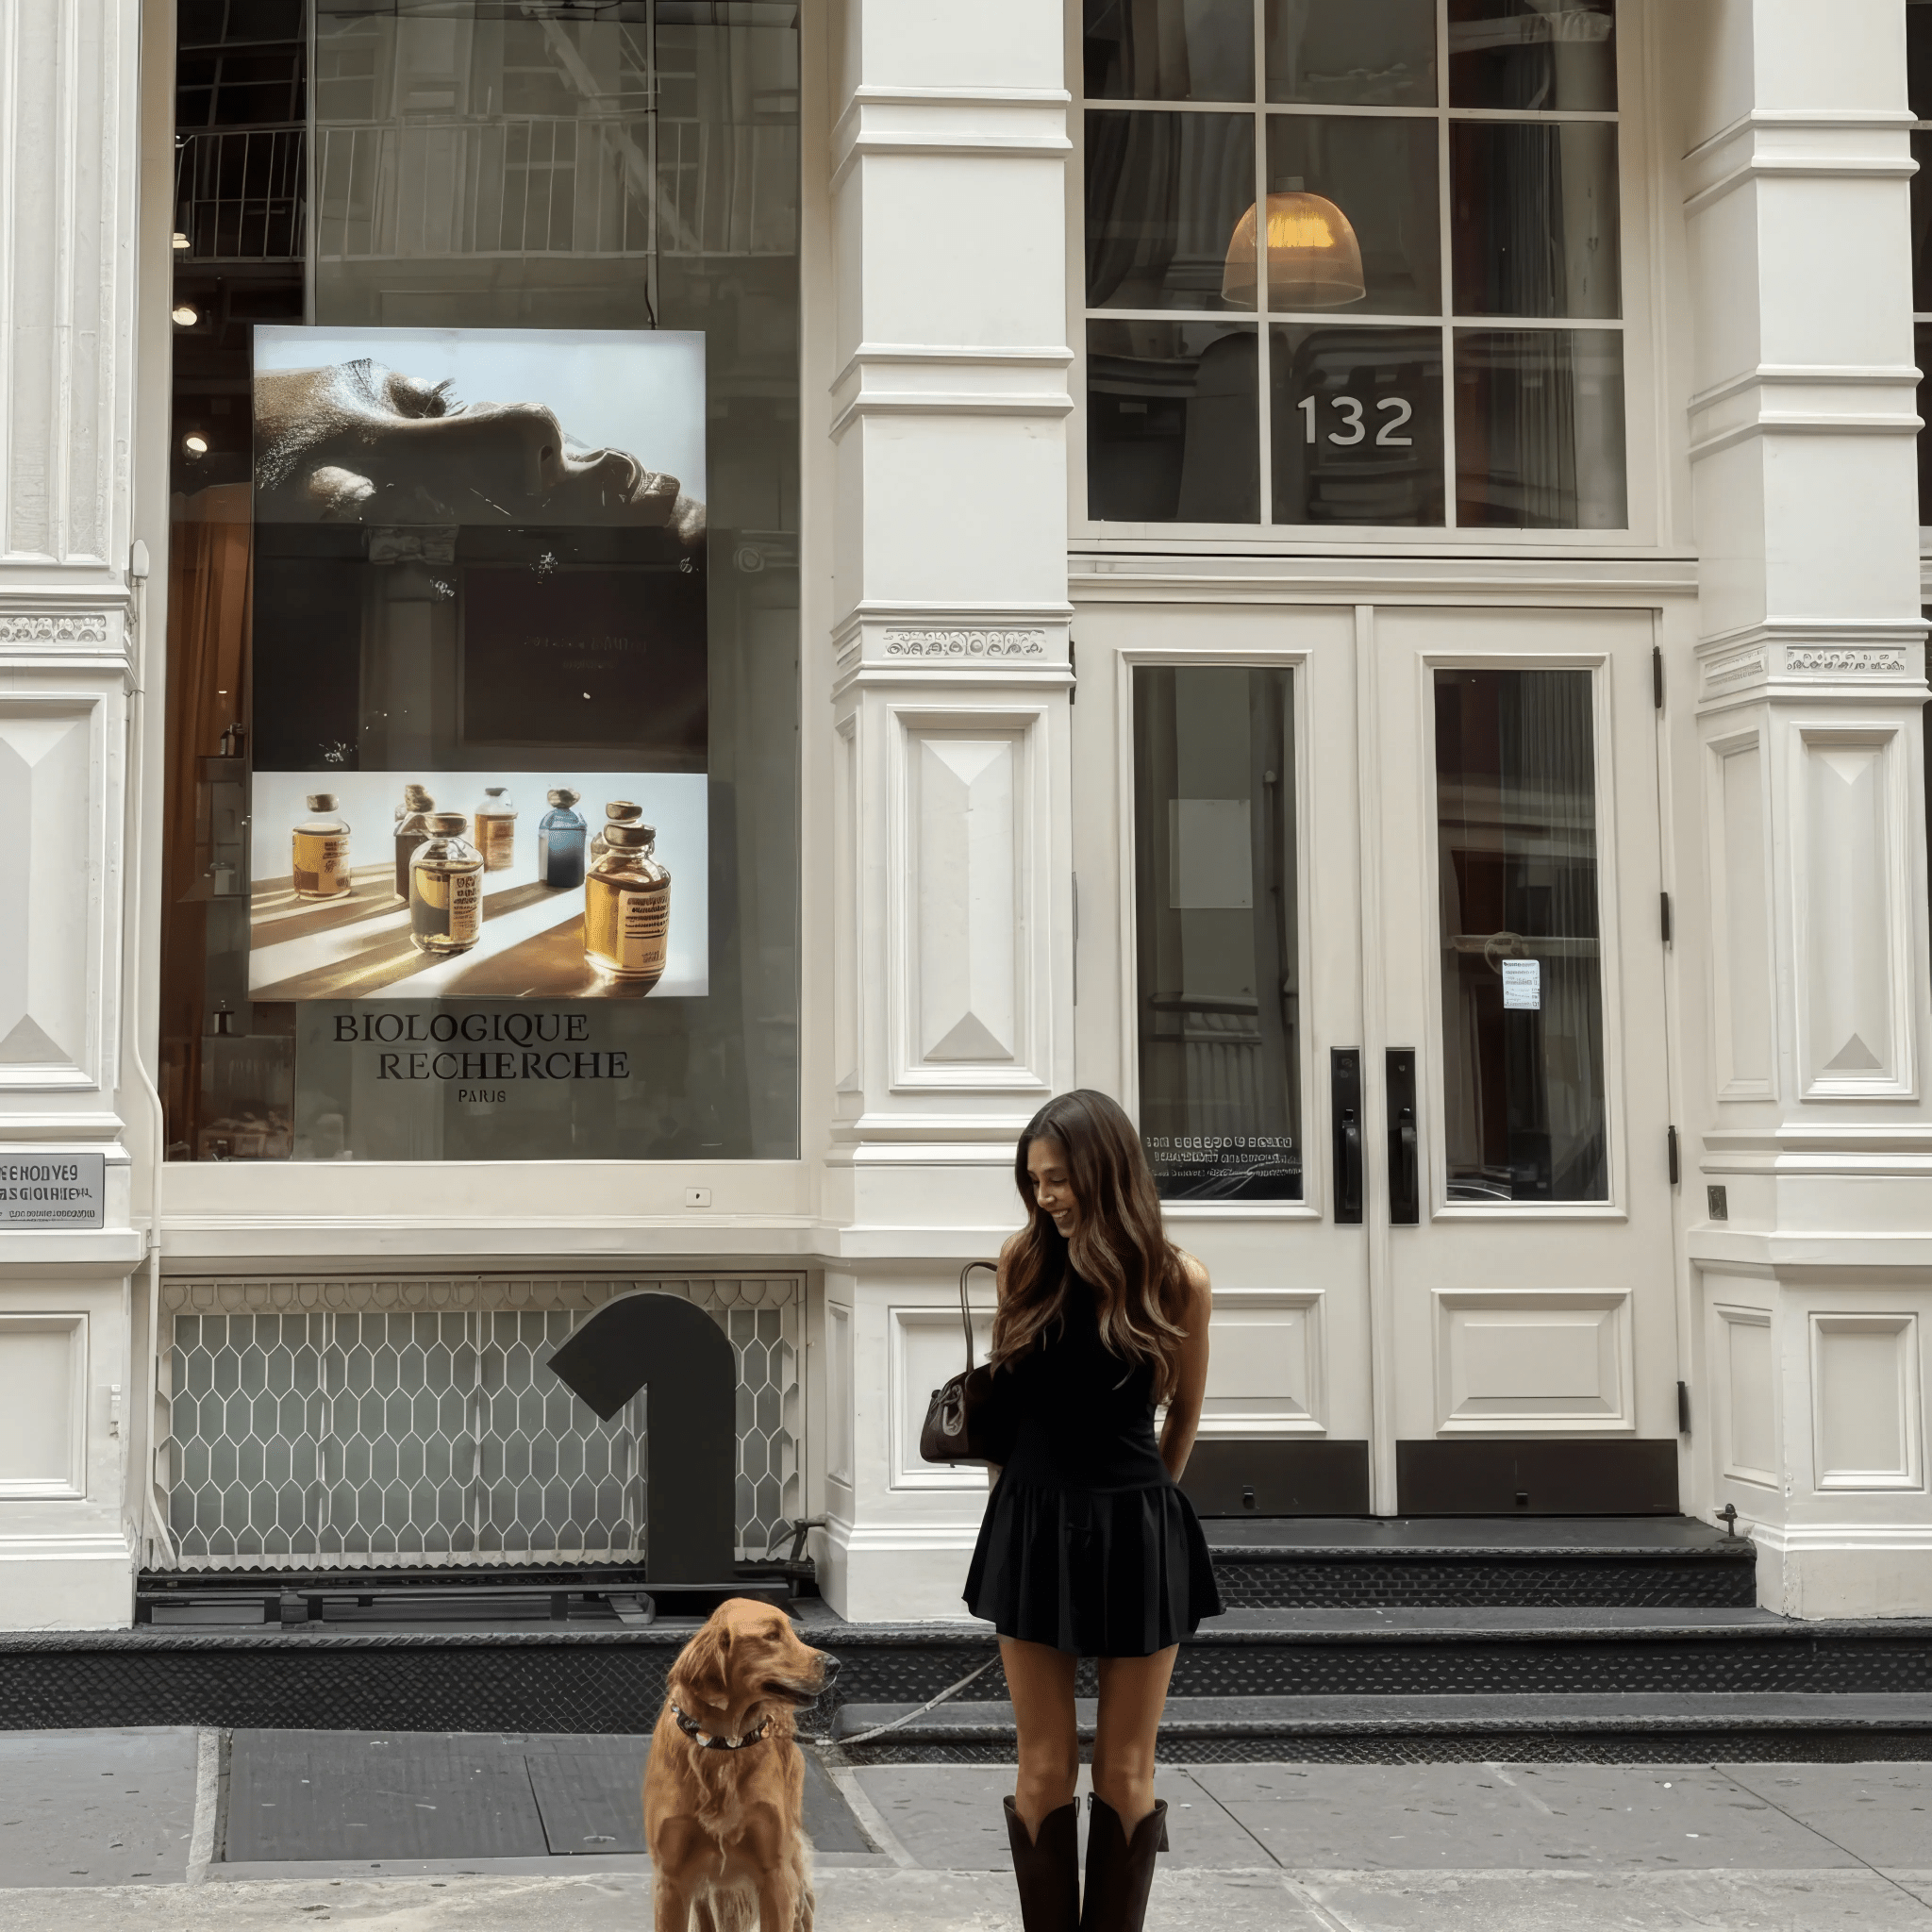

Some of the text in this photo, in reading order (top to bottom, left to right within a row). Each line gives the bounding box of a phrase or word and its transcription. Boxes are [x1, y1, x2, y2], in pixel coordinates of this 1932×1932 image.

[1297, 394, 1413, 446] 132
[332, 1013, 590, 1048] BIOLOGIQUE
[376, 1051, 630, 1080] RECHERCHE
